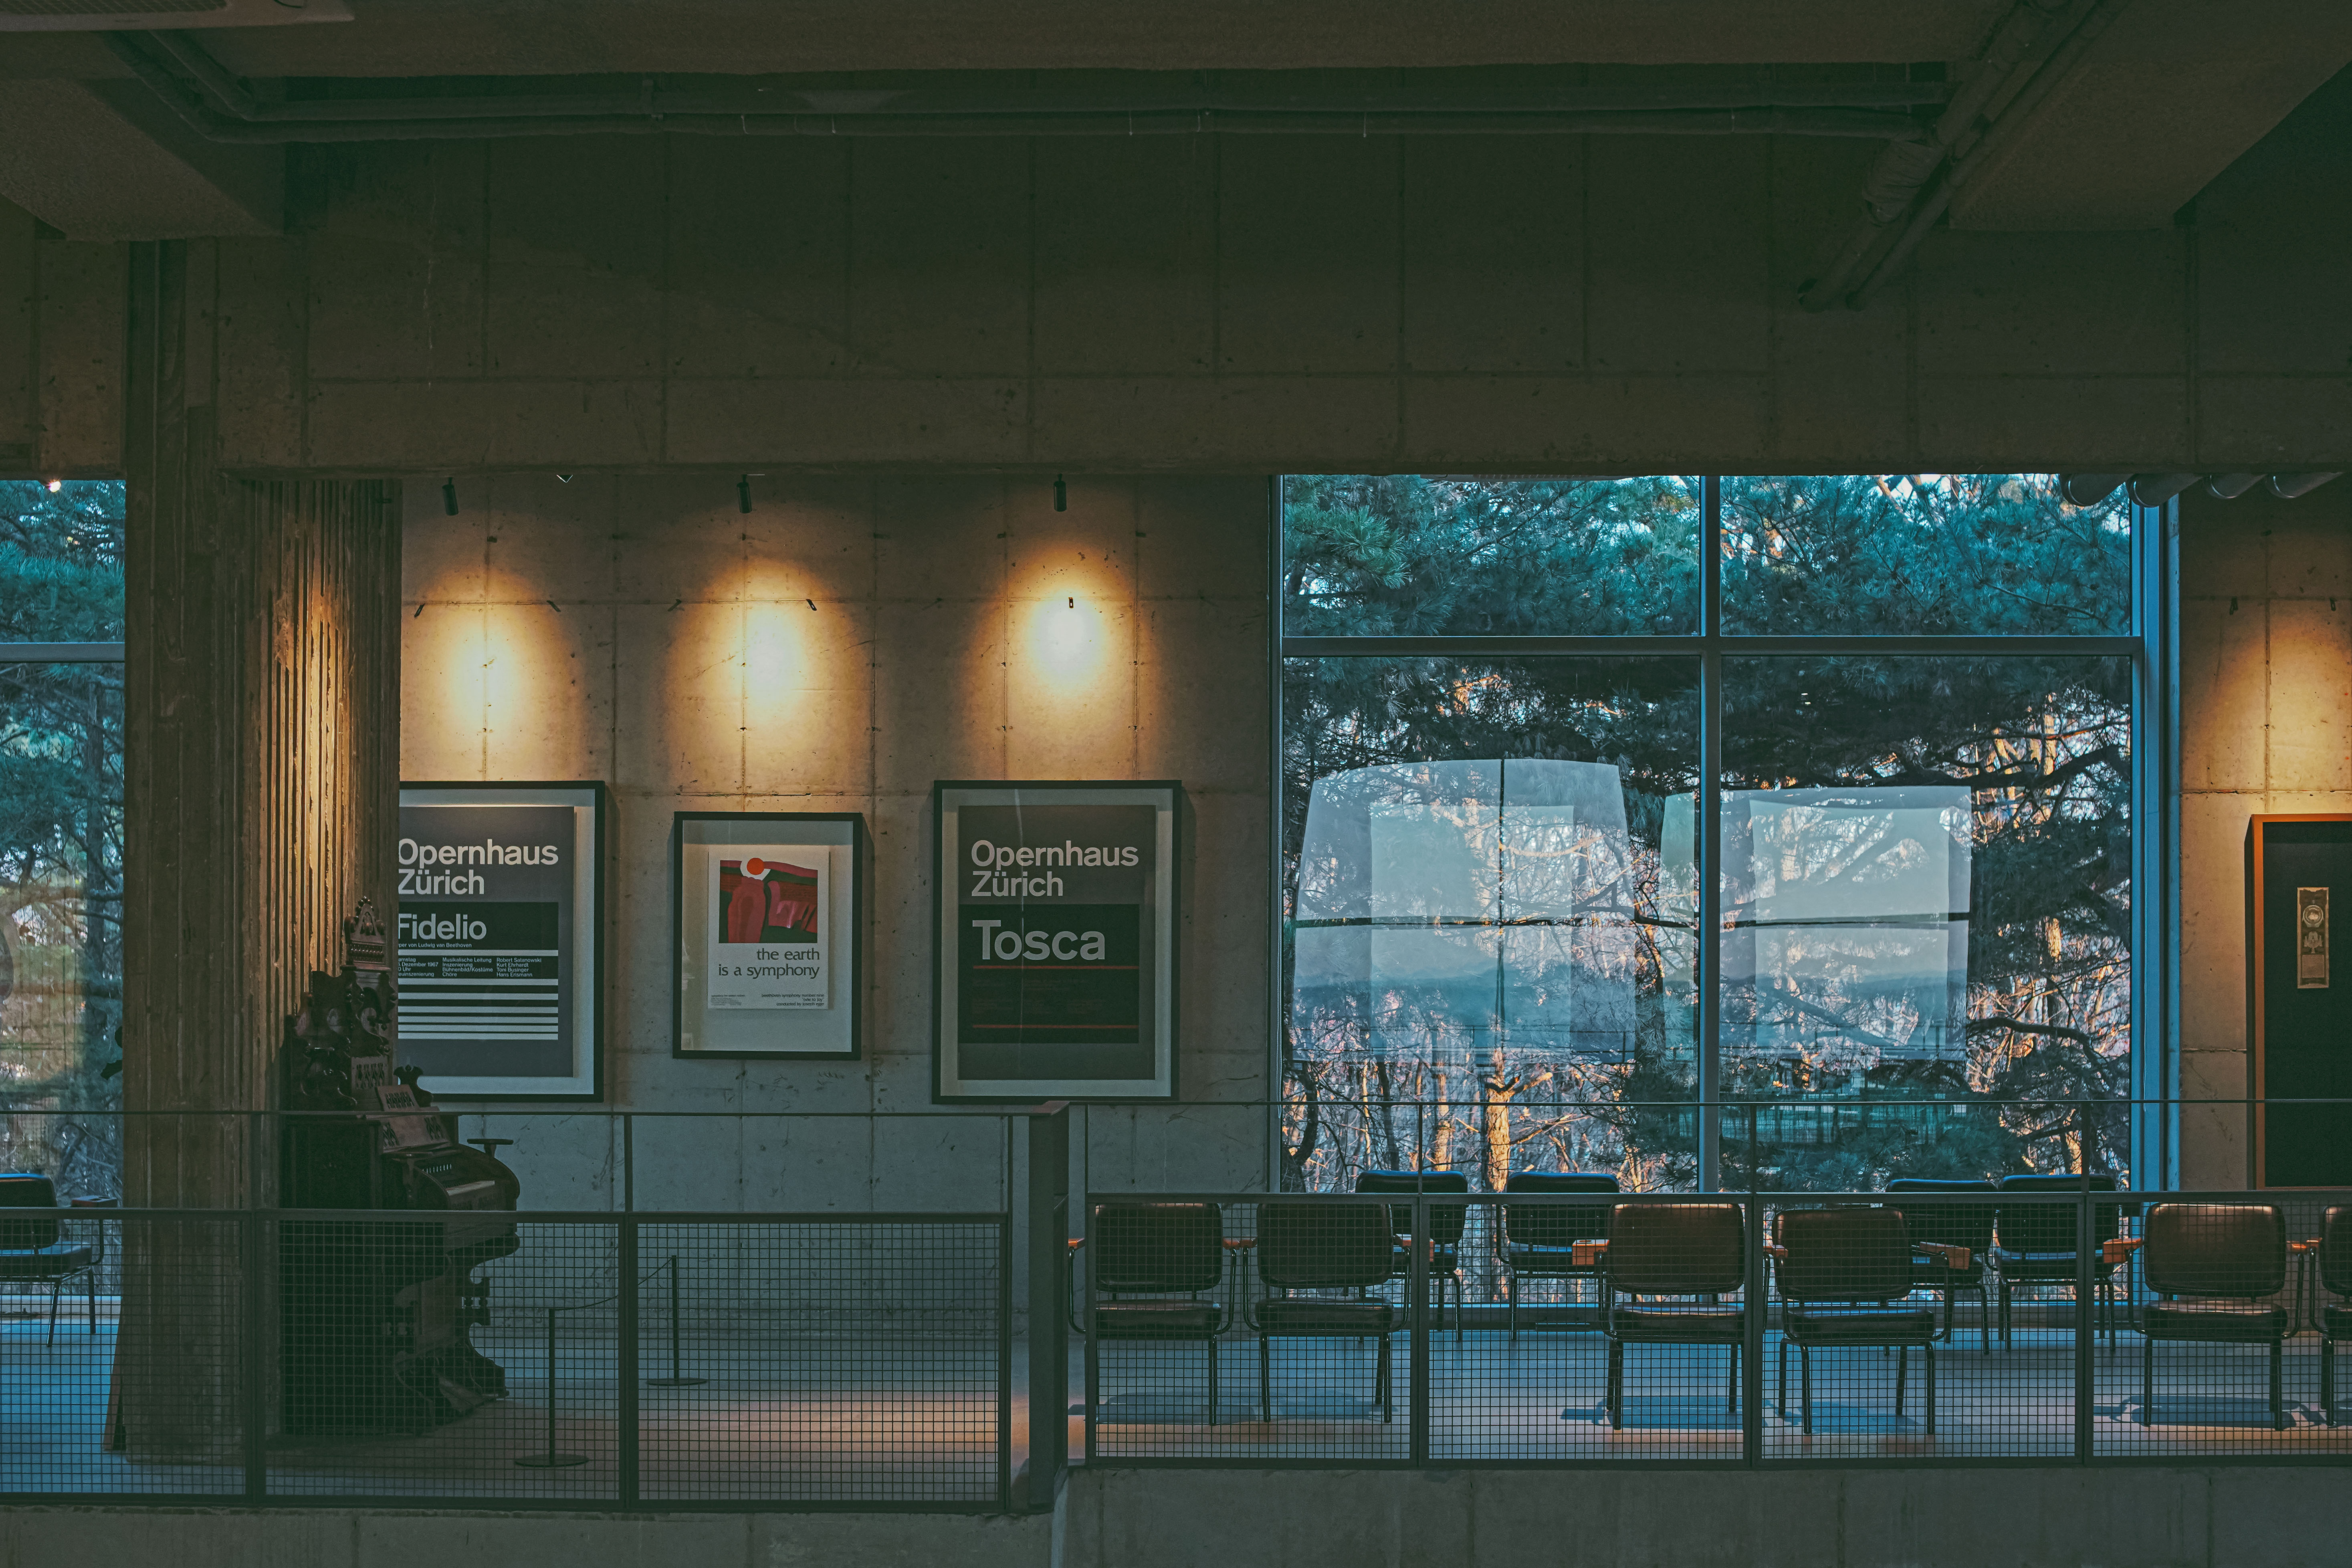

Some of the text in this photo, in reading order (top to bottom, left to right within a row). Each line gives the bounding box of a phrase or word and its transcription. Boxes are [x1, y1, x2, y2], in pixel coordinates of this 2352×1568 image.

[398, 838, 558, 869] Opernhaus
[971, 840, 1139, 871] Opernhaus
[398, 868, 485, 895] Zürich
[971, 870, 1063, 896] Zürich
[398, 913, 487, 940] Fidelio
[972, 920, 1105, 960] Tosca
[757, 948, 820, 960] the earth
[719, 963, 820, 979] is a symphony
